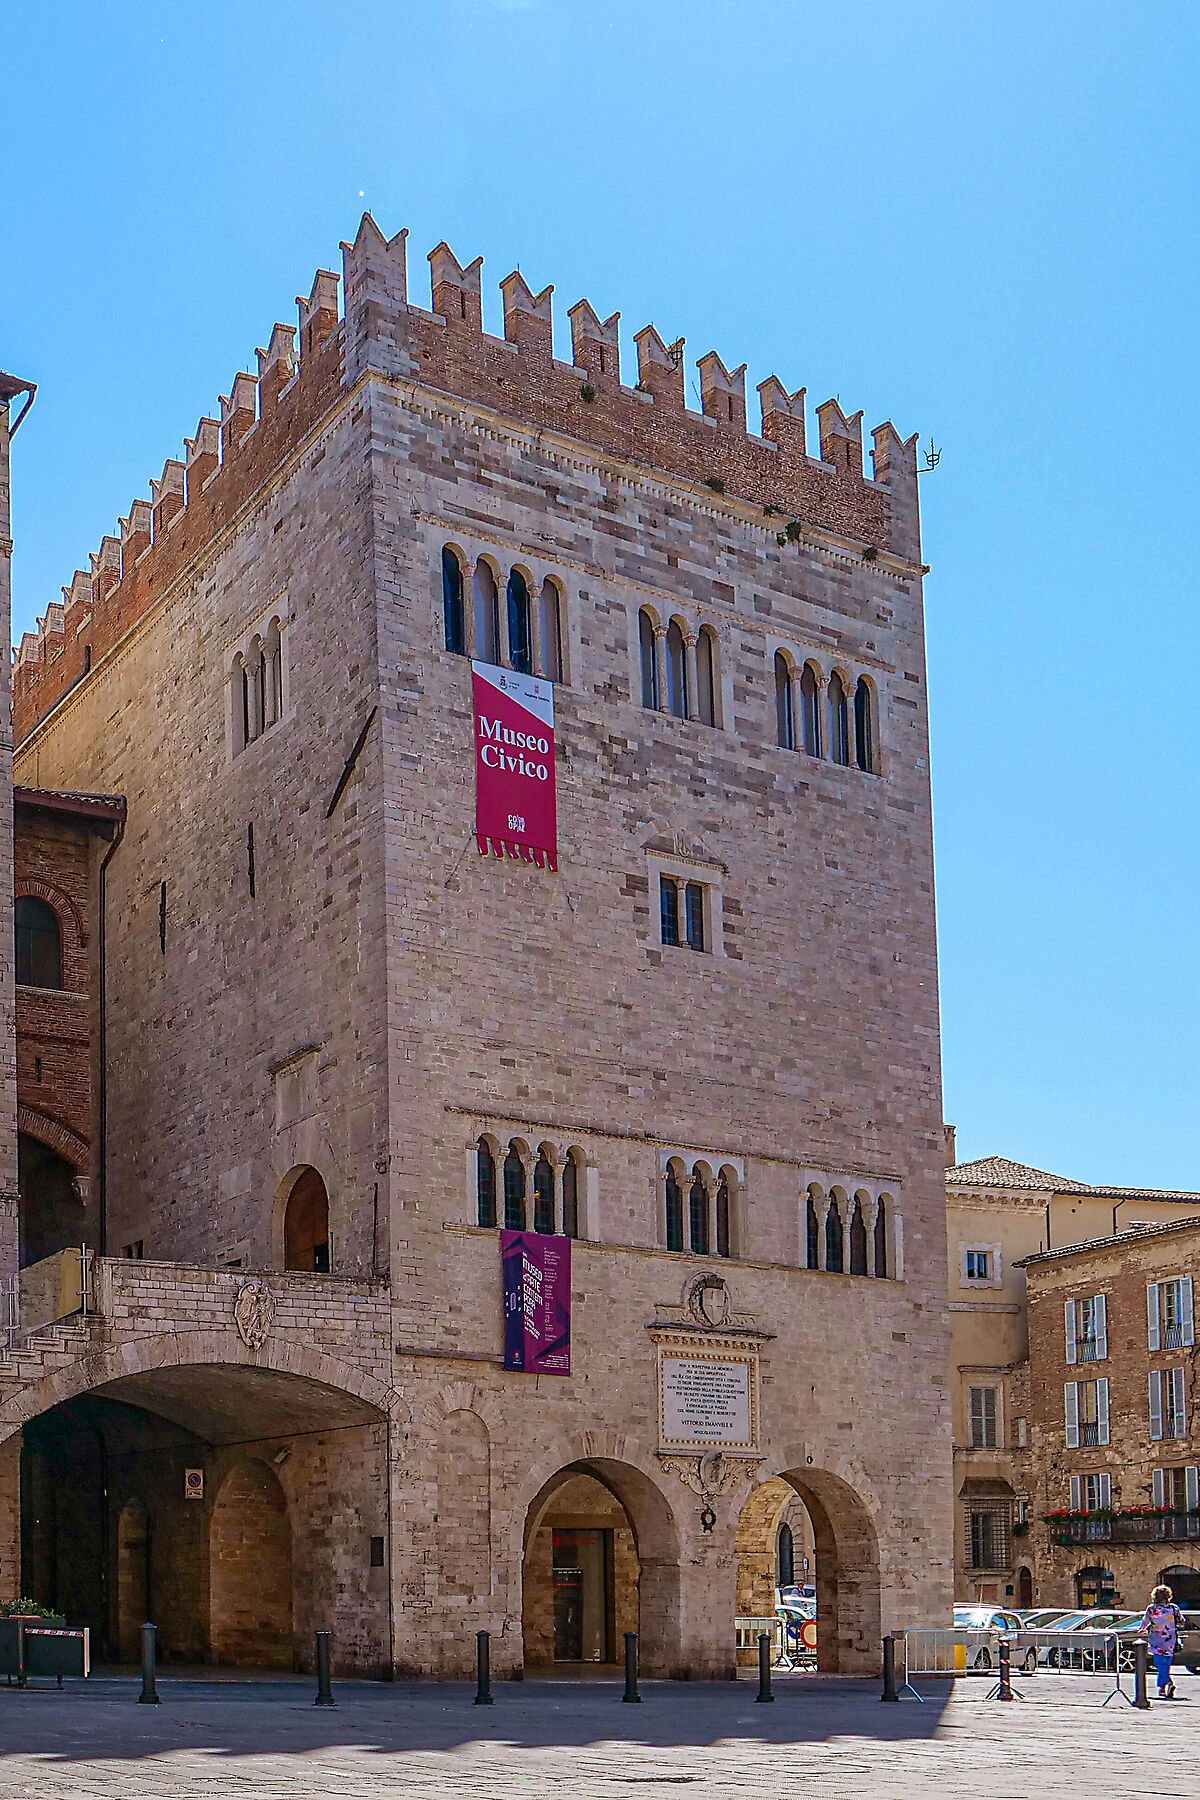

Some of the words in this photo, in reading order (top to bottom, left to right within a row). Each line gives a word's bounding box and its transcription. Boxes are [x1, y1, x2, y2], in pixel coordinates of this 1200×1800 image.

[478, 716, 549, 754] Museo
[481, 744, 548, 781] Civico
[523, 1258, 543, 1281] MUSEO
